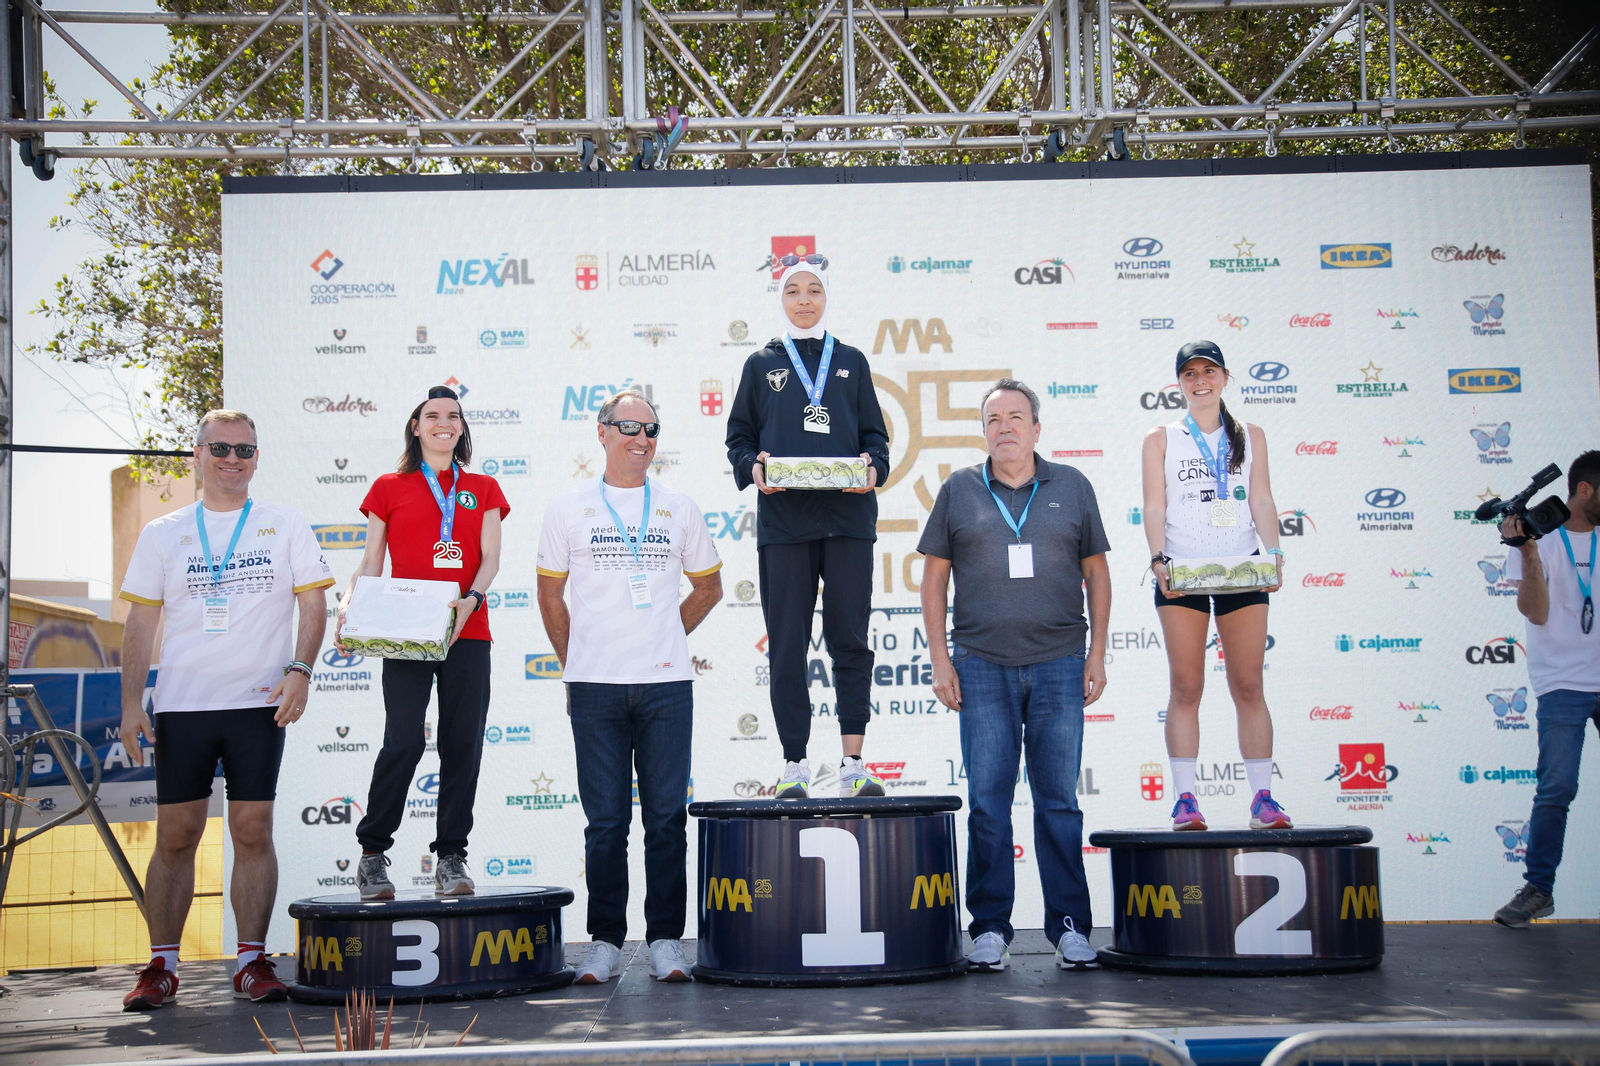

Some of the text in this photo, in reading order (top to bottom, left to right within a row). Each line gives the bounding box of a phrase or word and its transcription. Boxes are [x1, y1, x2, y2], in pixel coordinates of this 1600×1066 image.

[619, 250, 716, 271] ALMERÍA
[1330, 249, 1383, 262] IKEA
[911, 257, 973, 273] cajamar
[1114, 260, 1171, 270] HYUNDAI
[1209, 257, 1281, 269] ESTRELLA
[619, 275, 669, 287] CIUDAD
[1015, 267, 1062, 285] CASI
[1117, 271, 1170, 280] Almerialva
[310, 282, 395, 294] COOPERACIÓN
[310, 295, 339, 305] 2005
[1140, 318, 1174, 330] SER
[315, 343, 366, 355] vellsam
[1458, 374, 1513, 387] IKEA
[1241, 385, 1298, 394] HYUNDAI
[1336, 382, 1409, 393] ESTRELLA
[1243, 396, 1296, 405] Almerialva
[317, 473, 367, 485] vellsam
[1357, 511, 1414, 521] HYUNDAI
[1360, 523, 1413, 532] Almerialva
[433, 541, 463, 561] 25
[188, 554, 221, 564] Meio
[238, 556, 272, 569] 2024
[218, 572, 236, 580] RUIZ
[238, 567, 274, 577] ANDÚJAR
[1359, 635, 1422, 653] cajamar
[1465, 645, 1516, 664] CASI
[314, 671, 371, 681] HYUNDAI
[316, 682, 370, 692] Almerialva
[890, 699, 938, 715] RUIZ
[317, 741, 369, 753] vellsam
[1484, 766, 1539, 783] cajama
[1195, 784, 1235, 797] IUDAD
[506, 795, 579, 805] ESTRELLA
[302, 806, 351, 825] CASI
[317, 877, 358, 887] vellsa
[799, 827, 885, 967] 1
[1234, 851, 1313, 955] 2
[391, 919, 439, 987] 3
